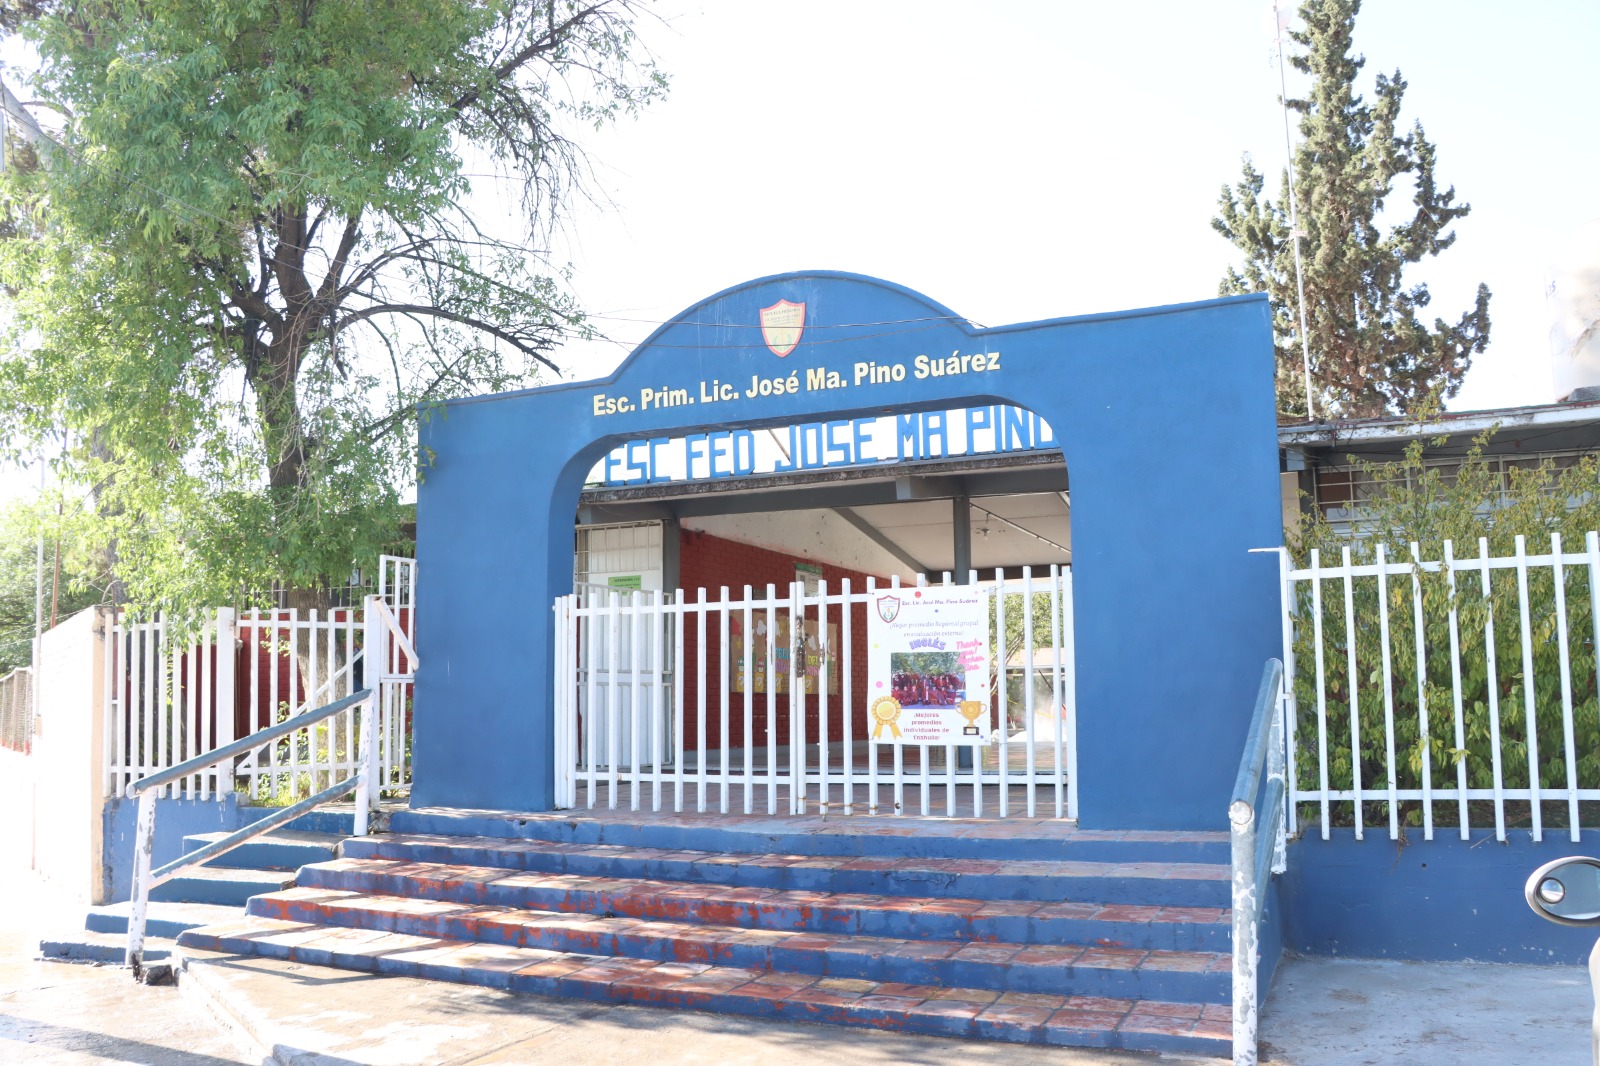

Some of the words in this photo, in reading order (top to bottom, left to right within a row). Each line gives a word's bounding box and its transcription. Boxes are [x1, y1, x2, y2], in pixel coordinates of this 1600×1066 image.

[593, 394, 635, 416] Esc.
[641, 386, 695, 410] Prim.
[700, 379, 739, 403] Lic.
[745, 370, 799, 398] José
[806, 367, 847, 391] Ma.
[854, 361, 906, 386] Pino
[914, 350, 1001, 379] Suárez
[605, 436, 671, 487] ESC
[685, 428, 755, 480] FED
[774, 417, 879, 472] JOSE
[897, 410, 948, 461] MA
[909, 637, 947, 651] INGLÉS
[956, 637, 981, 650] Thank
